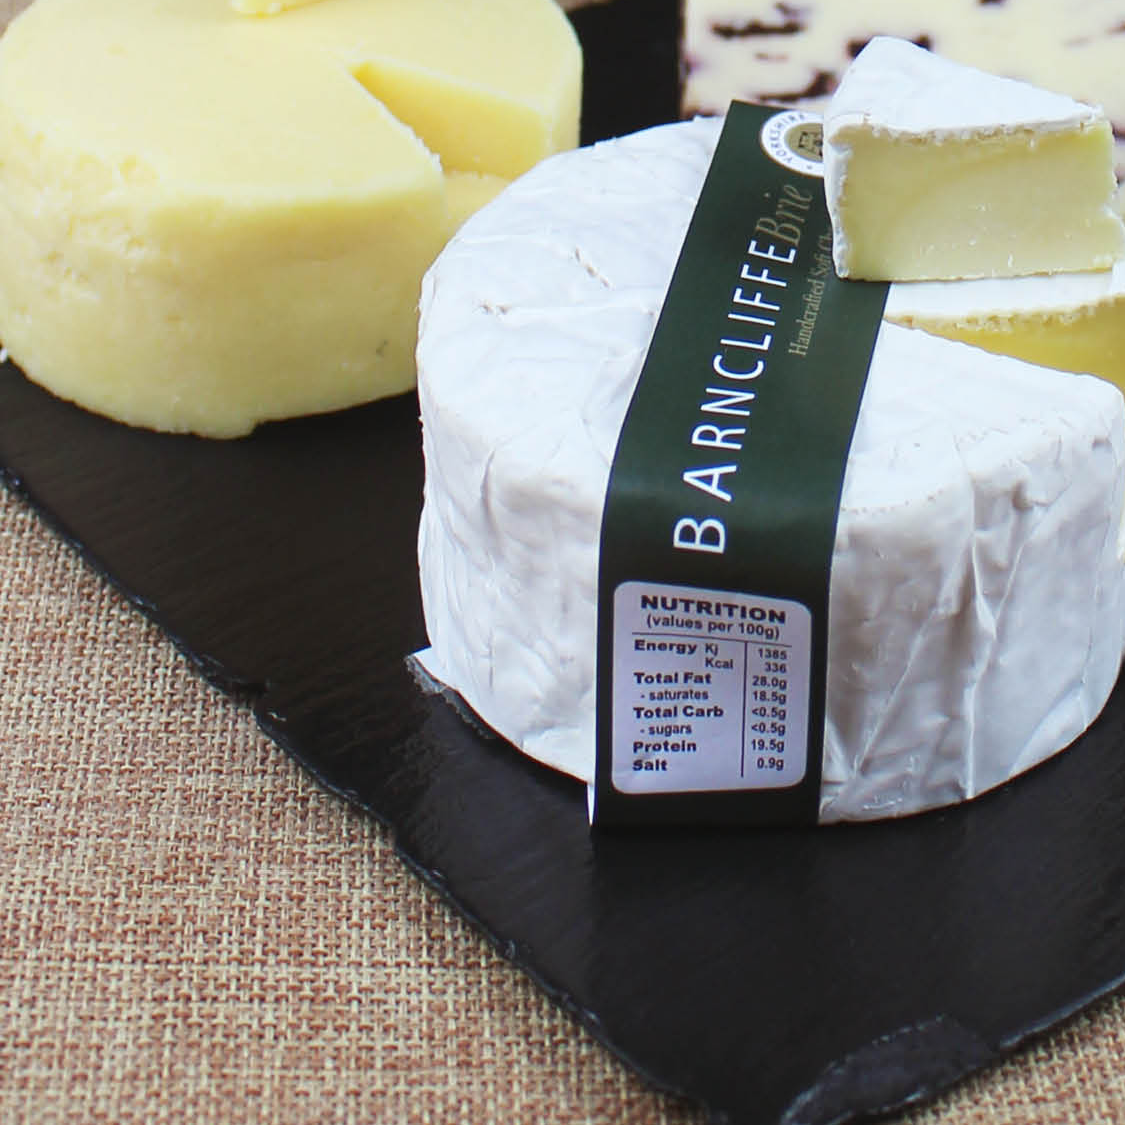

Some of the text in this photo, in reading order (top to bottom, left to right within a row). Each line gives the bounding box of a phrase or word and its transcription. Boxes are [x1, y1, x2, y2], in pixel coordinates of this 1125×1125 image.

[788, 278, 825, 356] Handcrafted
[672, 184, 814, 555] BARNCLIFFE Brie
[640, 594, 787, 625] NUTRITION
[647, 614, 780, 641] (values per 100g)
[634, 639, 787, 661] Energy Kj 1385
[704, 657, 787, 674] Kcal 336
[633, 672, 788, 690] Total Fat 28.0g
[648, 689, 709, 702] saturates
[752, 690, 787, 705] 18.5g
[633, 705, 787, 721] Total Carb <0.5g
[648, 724, 693, 738] sugars
[751, 723, 786, 737] <0.5g
[633, 739, 785, 754] Protein 19.5g
[632, 757, 785, 772] Salt 0.9g
